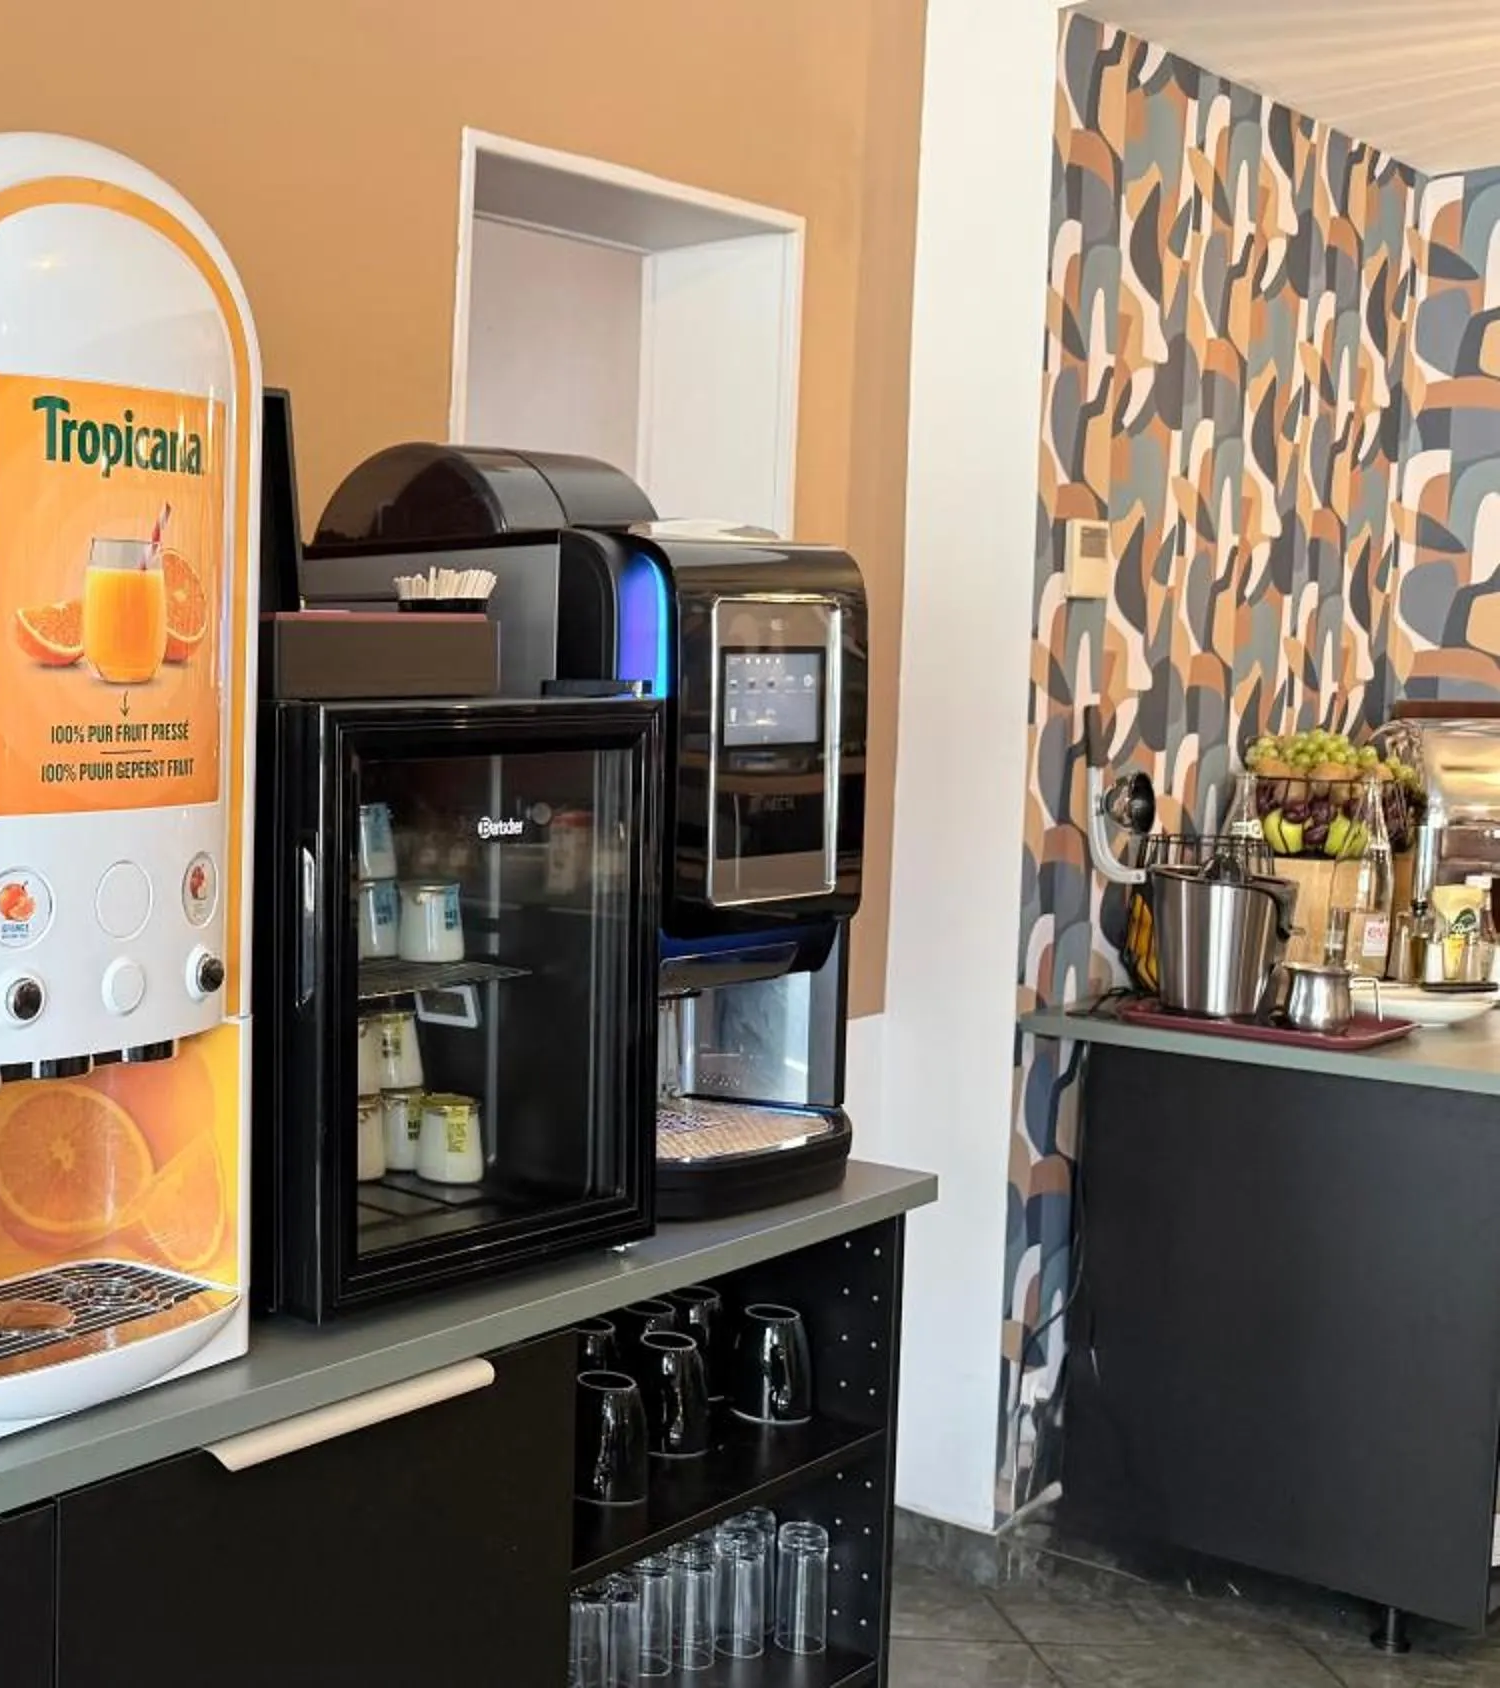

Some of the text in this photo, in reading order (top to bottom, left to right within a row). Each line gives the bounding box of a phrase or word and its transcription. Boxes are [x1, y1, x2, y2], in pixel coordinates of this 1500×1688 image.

[32, 396, 202, 478] Tropicana
[51, 719, 189, 744] 100% PUR FRUIT PRESSÉ
[41, 763, 77, 783] 100%
[79, 762, 113, 781] PUUR
[115, 759, 165, 779] GEPERST
